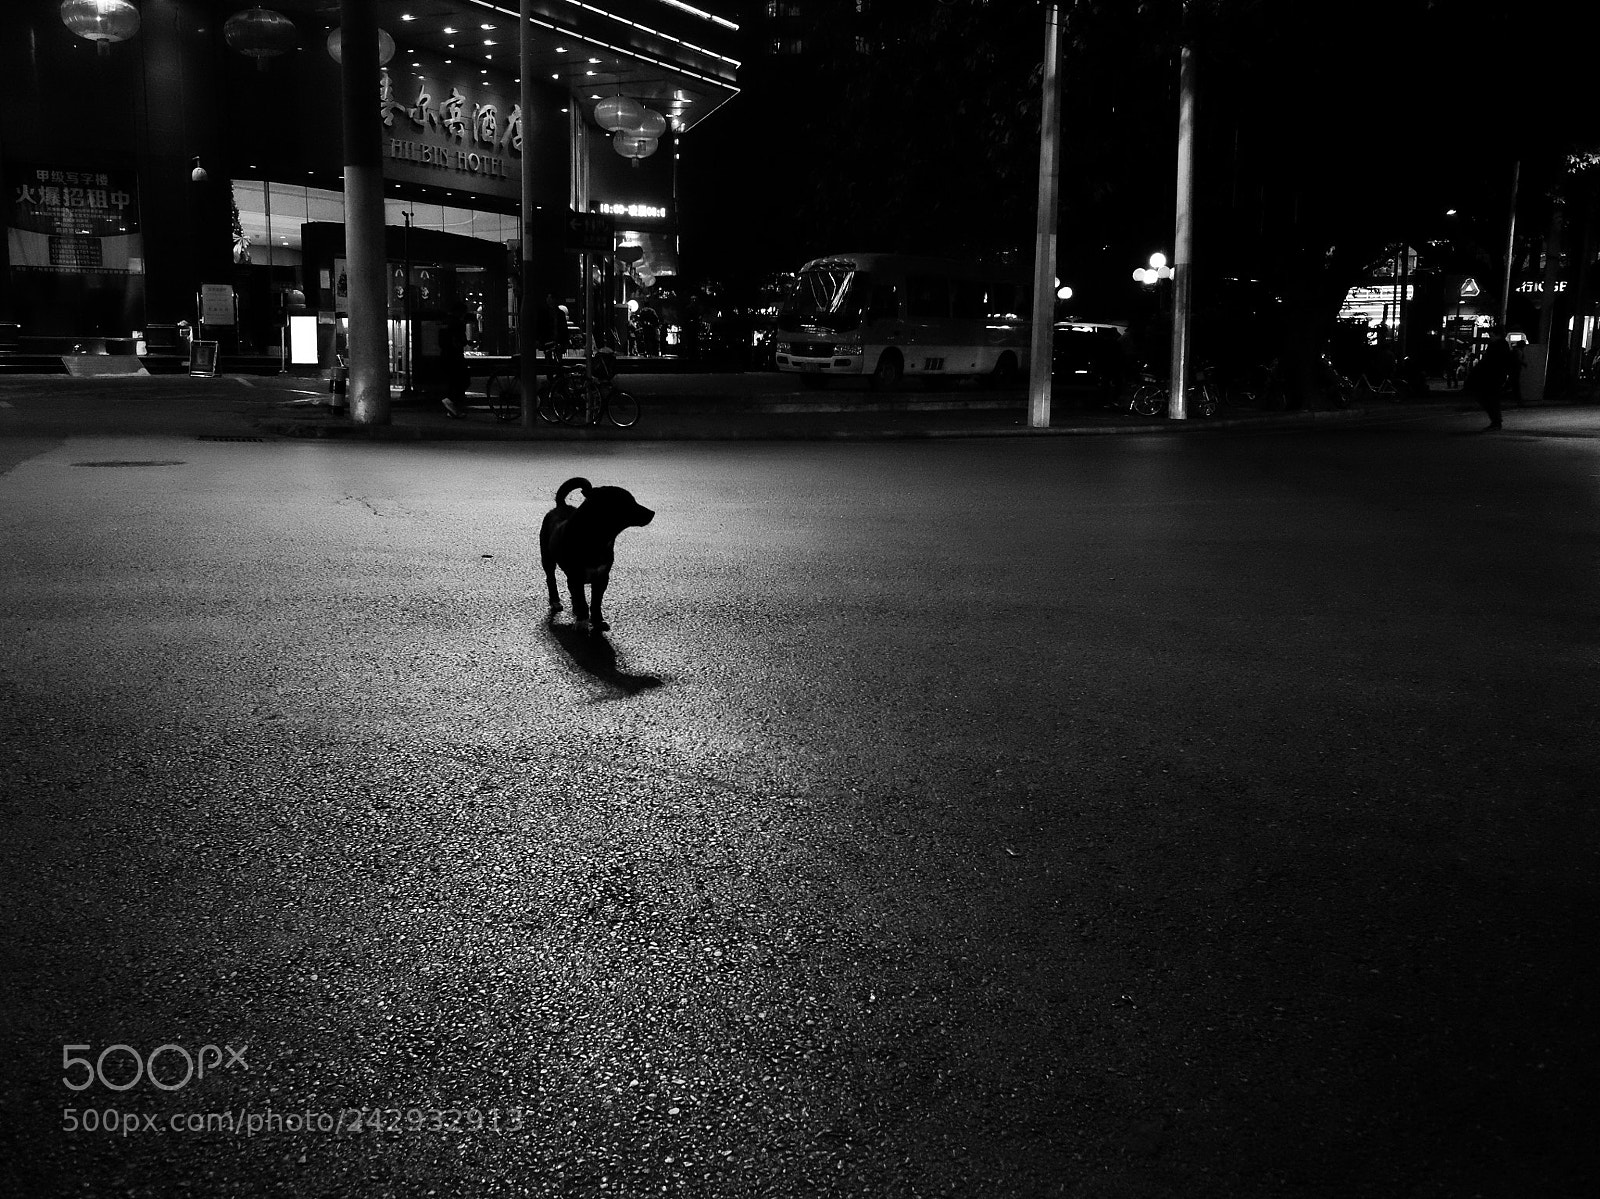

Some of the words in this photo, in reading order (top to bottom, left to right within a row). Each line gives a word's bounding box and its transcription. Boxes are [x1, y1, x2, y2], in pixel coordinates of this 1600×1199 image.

[36, 169, 110, 186] 甲级写字楼
[456, 151, 505, 178] HOTEL
[15, 184, 131, 210] 火爆招租中
